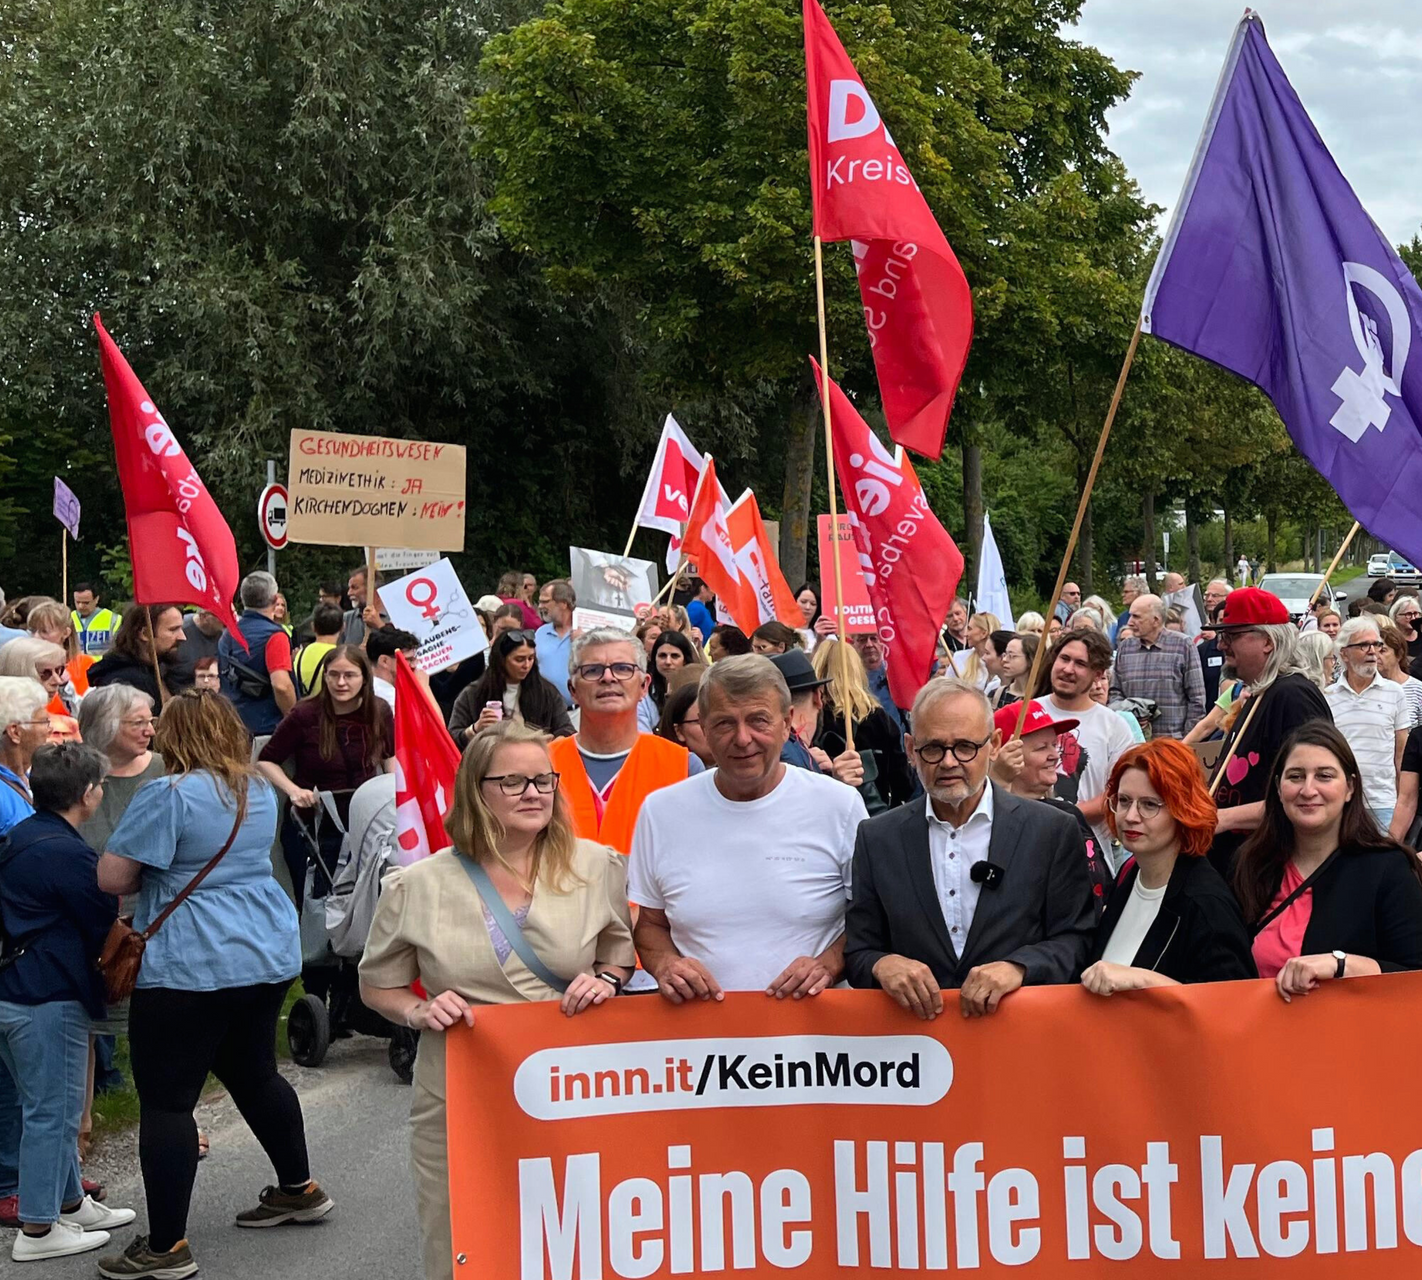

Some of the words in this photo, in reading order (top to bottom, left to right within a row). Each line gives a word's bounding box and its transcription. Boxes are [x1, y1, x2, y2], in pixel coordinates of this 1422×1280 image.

[401, 478, 424, 495] JA
[549, 1051, 921, 1103] innn.it/KeinMord
[518, 1143, 813, 1280] Meine
[833, 1138, 1042, 1271] Hilfe
[1062, 1135, 1182, 1261] ist
